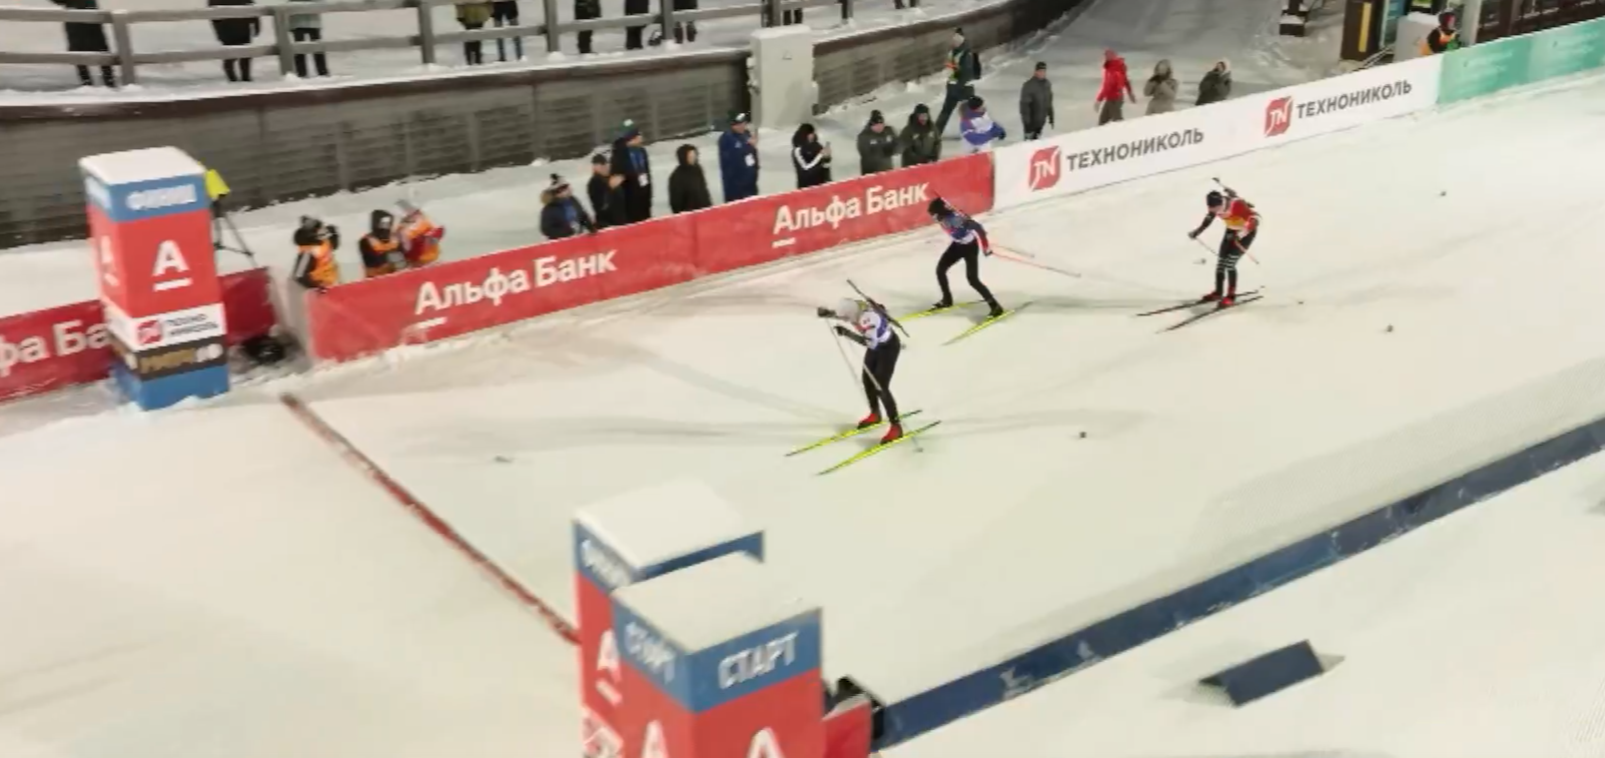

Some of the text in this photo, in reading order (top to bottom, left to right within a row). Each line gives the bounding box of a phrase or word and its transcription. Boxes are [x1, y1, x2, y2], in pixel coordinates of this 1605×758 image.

[1296, 80, 1412, 118] ТЕХНОНИКОЛЬ
[1066, 128, 1204, 172] ТЕХНОНИКОЛЬ
[773, 182, 930, 235] Альфа Банк
[414, 249, 618, 316] Альфа Банк
[718, 631, 799, 690] СТАРТ
